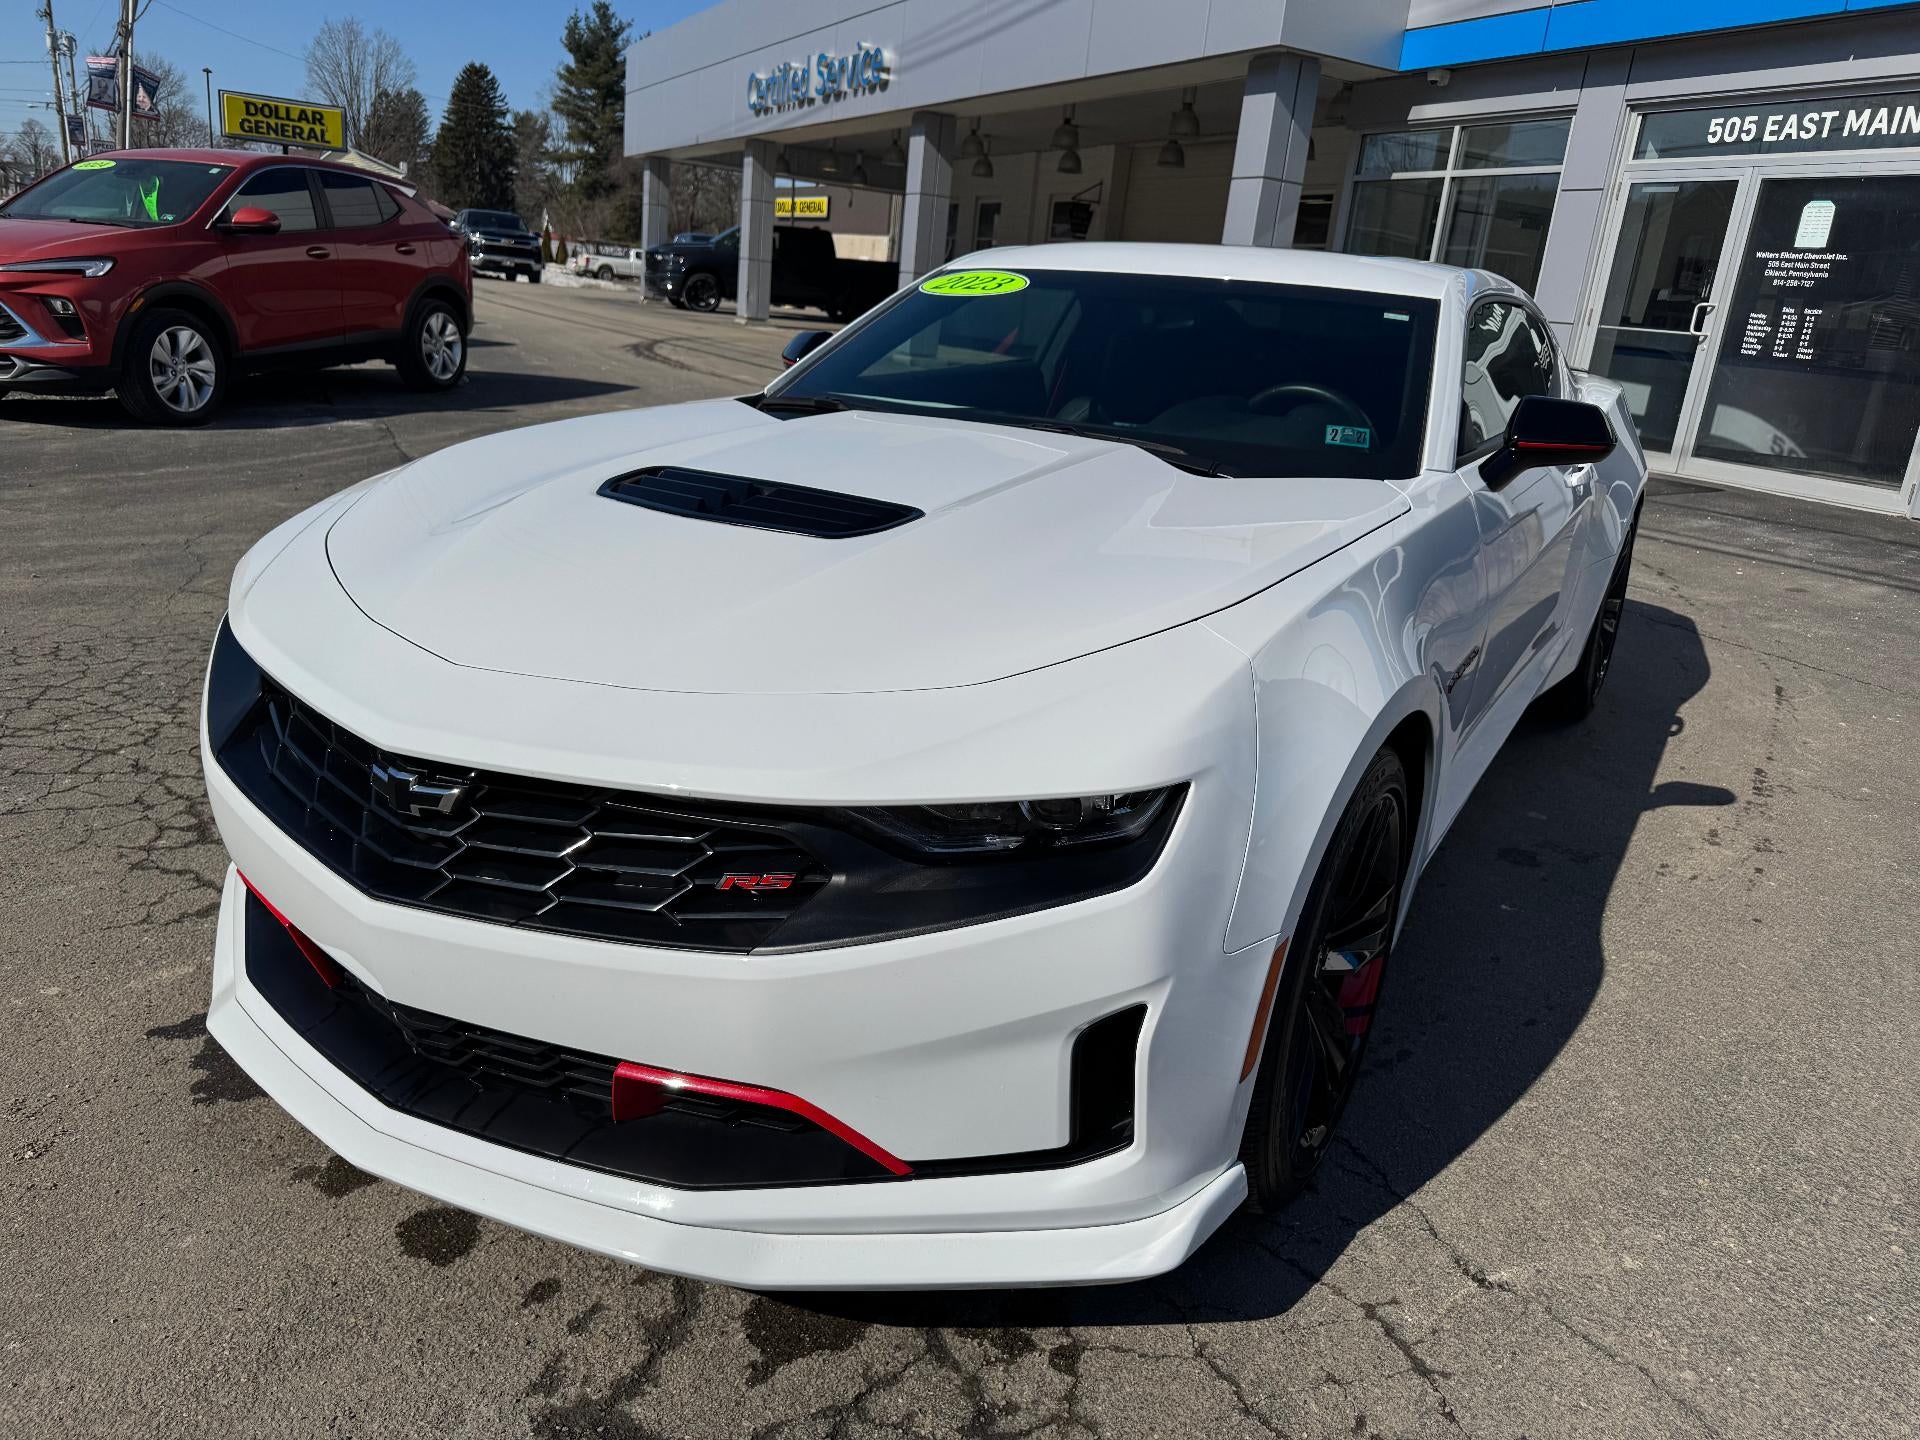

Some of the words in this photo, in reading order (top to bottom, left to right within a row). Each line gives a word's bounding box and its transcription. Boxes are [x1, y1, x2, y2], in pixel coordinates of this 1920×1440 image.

[747, 55, 811, 111] Certified
[815, 40, 884, 96] Service
[243, 100, 325, 126] DOLLAR
[239, 118, 331, 144] GENERAL
[1707, 116, 1759, 144] 505
[1762, 110, 1840, 142] EAST
[1842, 105, 1920, 137] MAIN
[799, 200, 825, 213] GENERAL
[1804, 252, 1835, 260] Chevrolet
[1835, 253, 1848, 261] Inc.
[1794, 261, 1809, 269] Main
[1810, 262, 1831, 270] Street
[1788, 269, 1829, 278] Pennsylvania
[929, 276, 1015, 291] 2023
[1329, 428, 1339, 442] 2
[714, 872, 797, 890] RS
